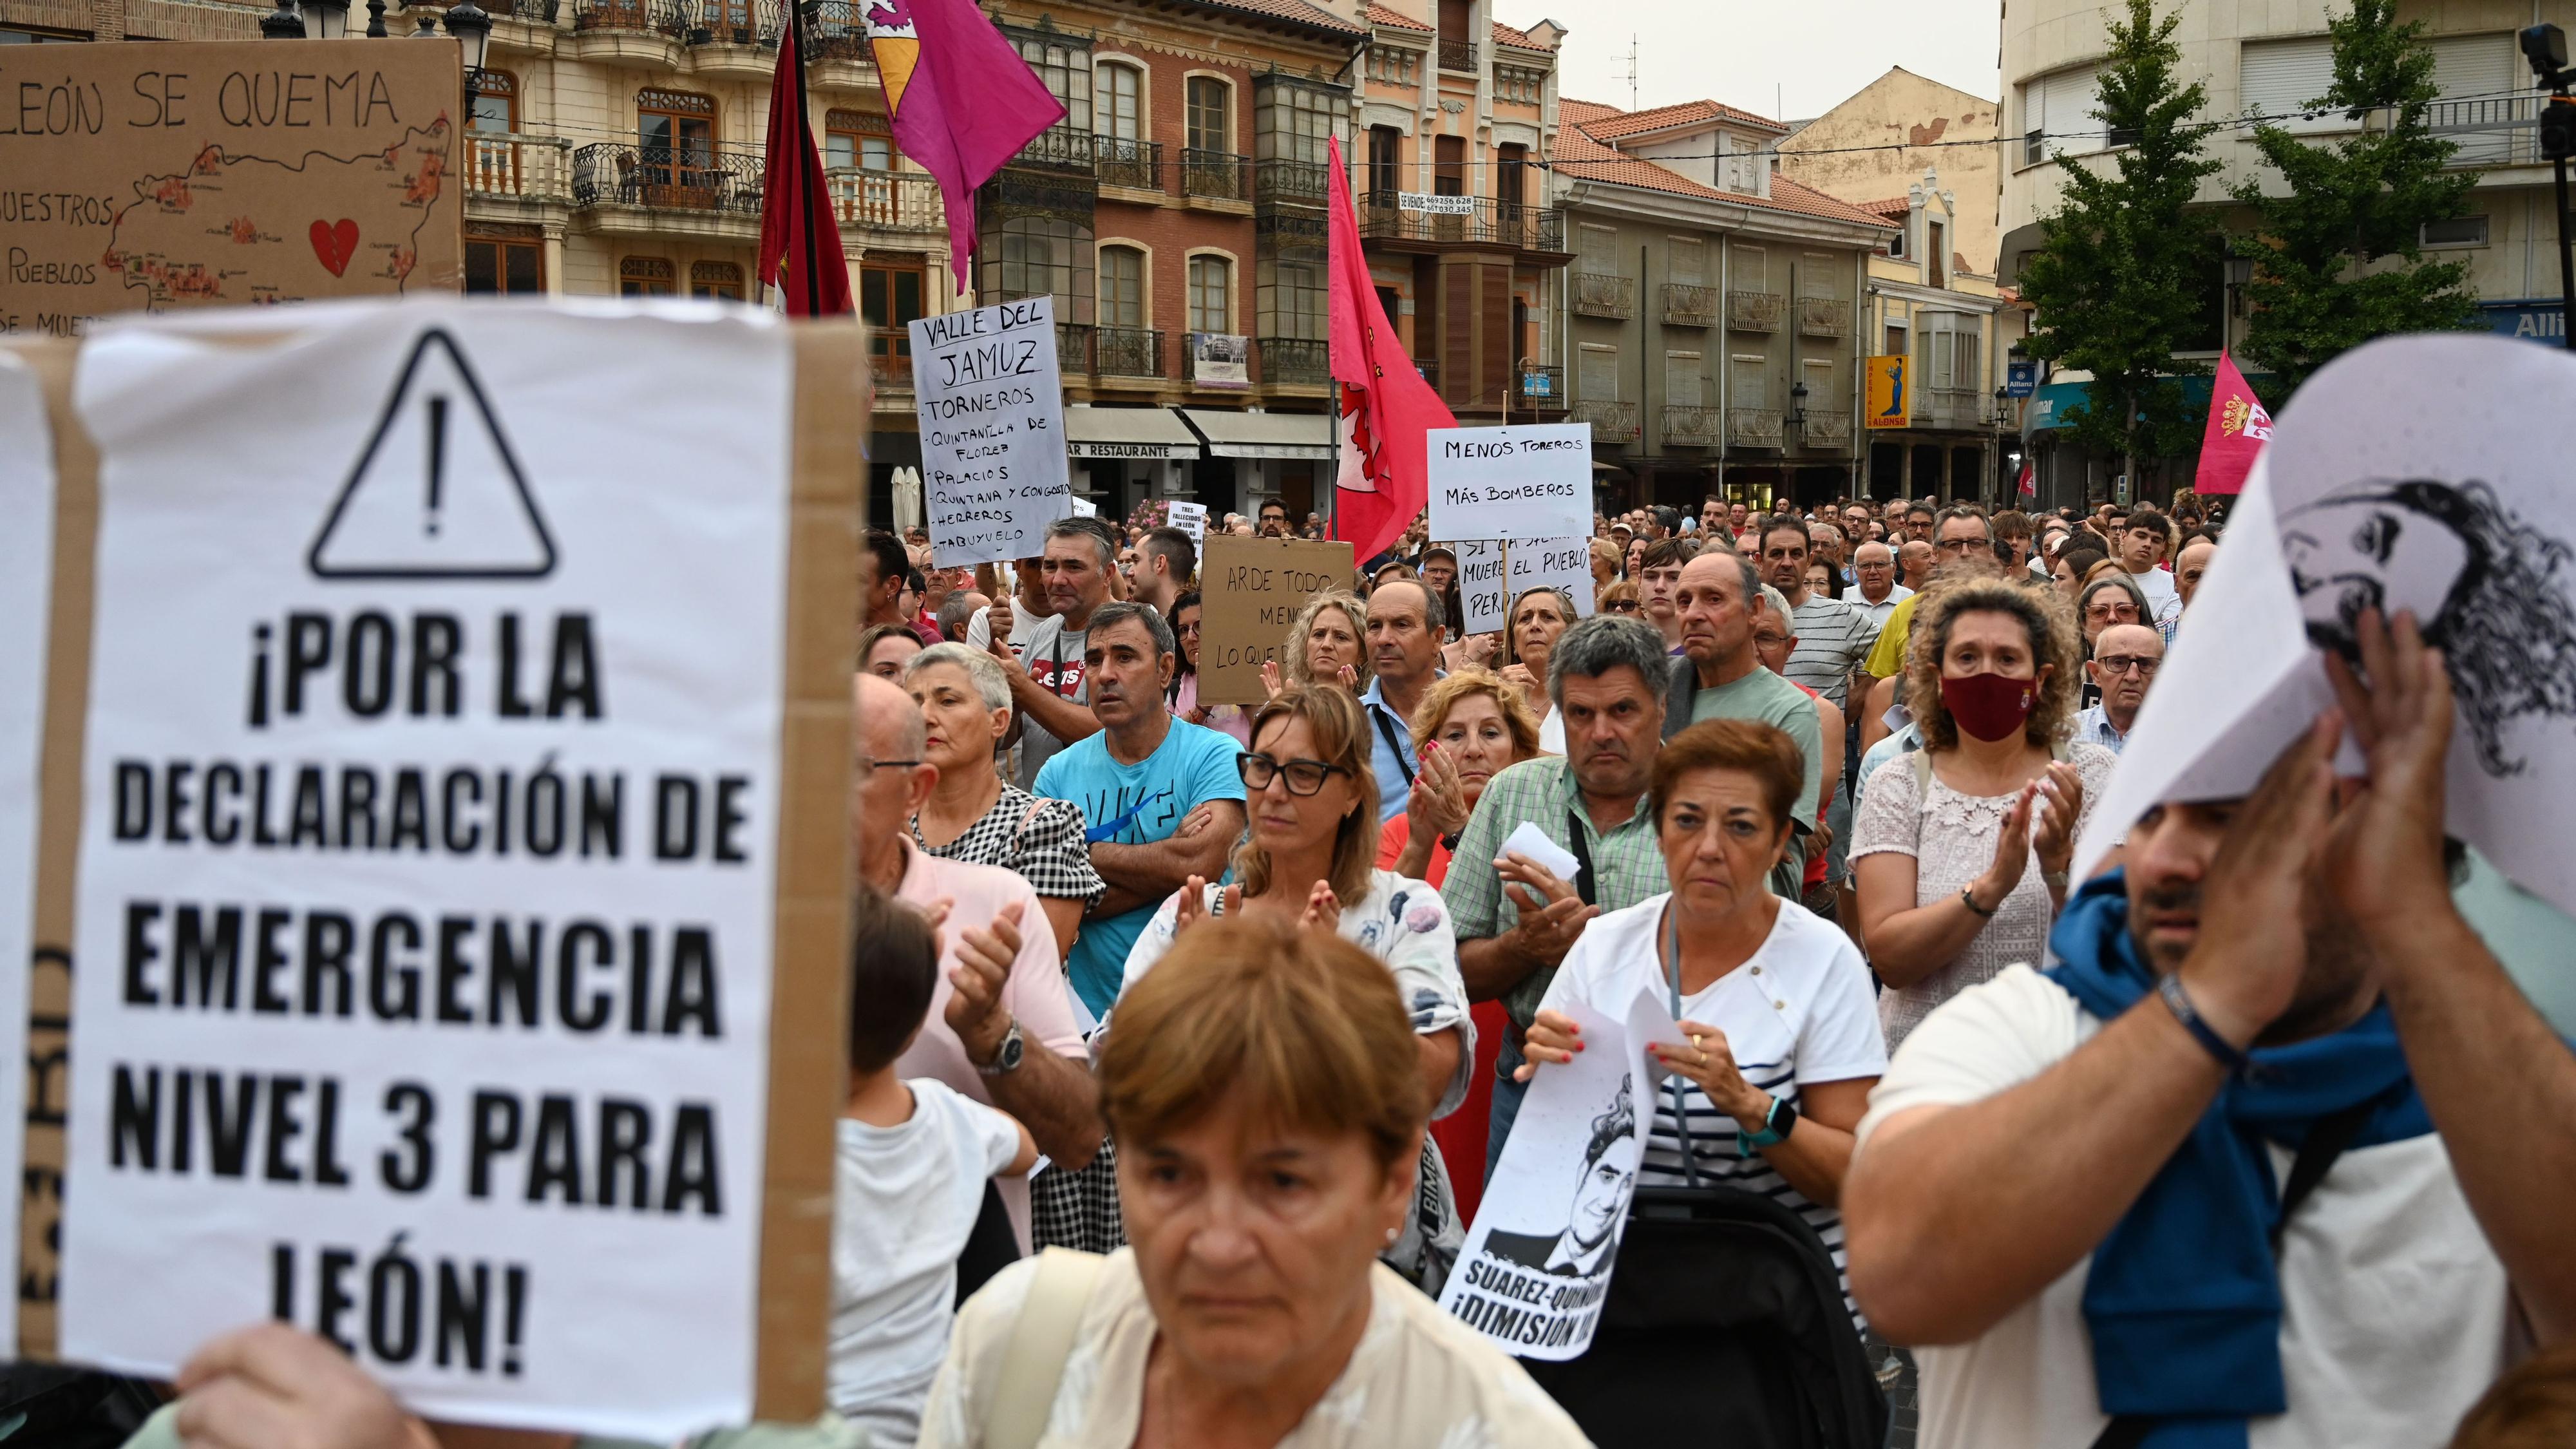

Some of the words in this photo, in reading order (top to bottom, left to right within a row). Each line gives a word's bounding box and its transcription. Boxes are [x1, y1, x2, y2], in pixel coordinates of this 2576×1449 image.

[128, 71, 187, 128] SE
[219, 70, 400, 128] QUEMA
[0, 192, 113, 226] UESTROS
[1401, 194, 1407, 207] SE
[1408, 196, 1426, 209] VENDE:
[924, 310, 987, 347] VALLE
[999, 302, 1043, 330] DEL
[2514, 312, 2565, 337] Alli
[940, 340, 1037, 386] JAMUZ
[925, 388, 1034, 421] TORNEROS
[1028, 417, 1047, 431] DE
[1873, 417, 1906, 426] ALONSO
[1068, 444, 1081, 455] AR
[1090, 445, 1170, 457] RESTAURANTE
[1446, 441, 1513, 459] MENOS
[1520, 439, 1583, 452] TOREROS
[934, 466, 1009, 486] PALACIOS
[936, 490, 1002, 505] QUINTANA
[1009, 488, 1016, 498] Y
[1021, 483, 1071, 497] CONGOSTO
[1446, 488, 1479, 506] MÁS
[1485, 484, 1575, 501] BOMBEROS
[1173, 513, 1201, 522] FALLECIDOS
[1463, 560, 1504, 584] MUERE
[1513, 559, 1531, 575] EL
[1543, 548, 1587, 573] PUEBLO
[1227, 566, 1273, 592] ARDE
[1283, 570, 1332, 592] TODO
[1260, 606, 1302, 625] MENO
[1217, 645, 1239, 668] LO
[1245, 646, 1274, 665] QUE
[248, 609, 462, 730] ¡POR
[496, 612, 604, 721] LA
[113, 749, 624, 860] DECLARACIÓN
[653, 774, 749, 864] DE
[122, 900, 723, 1039] EMERGENCIA
[109, 1062, 350, 1188] NIVEL
[379, 1080, 437, 1195] 3
[467, 1088, 723, 1217] PARA
[271, 1231, 529, 1377] LEÓN!
